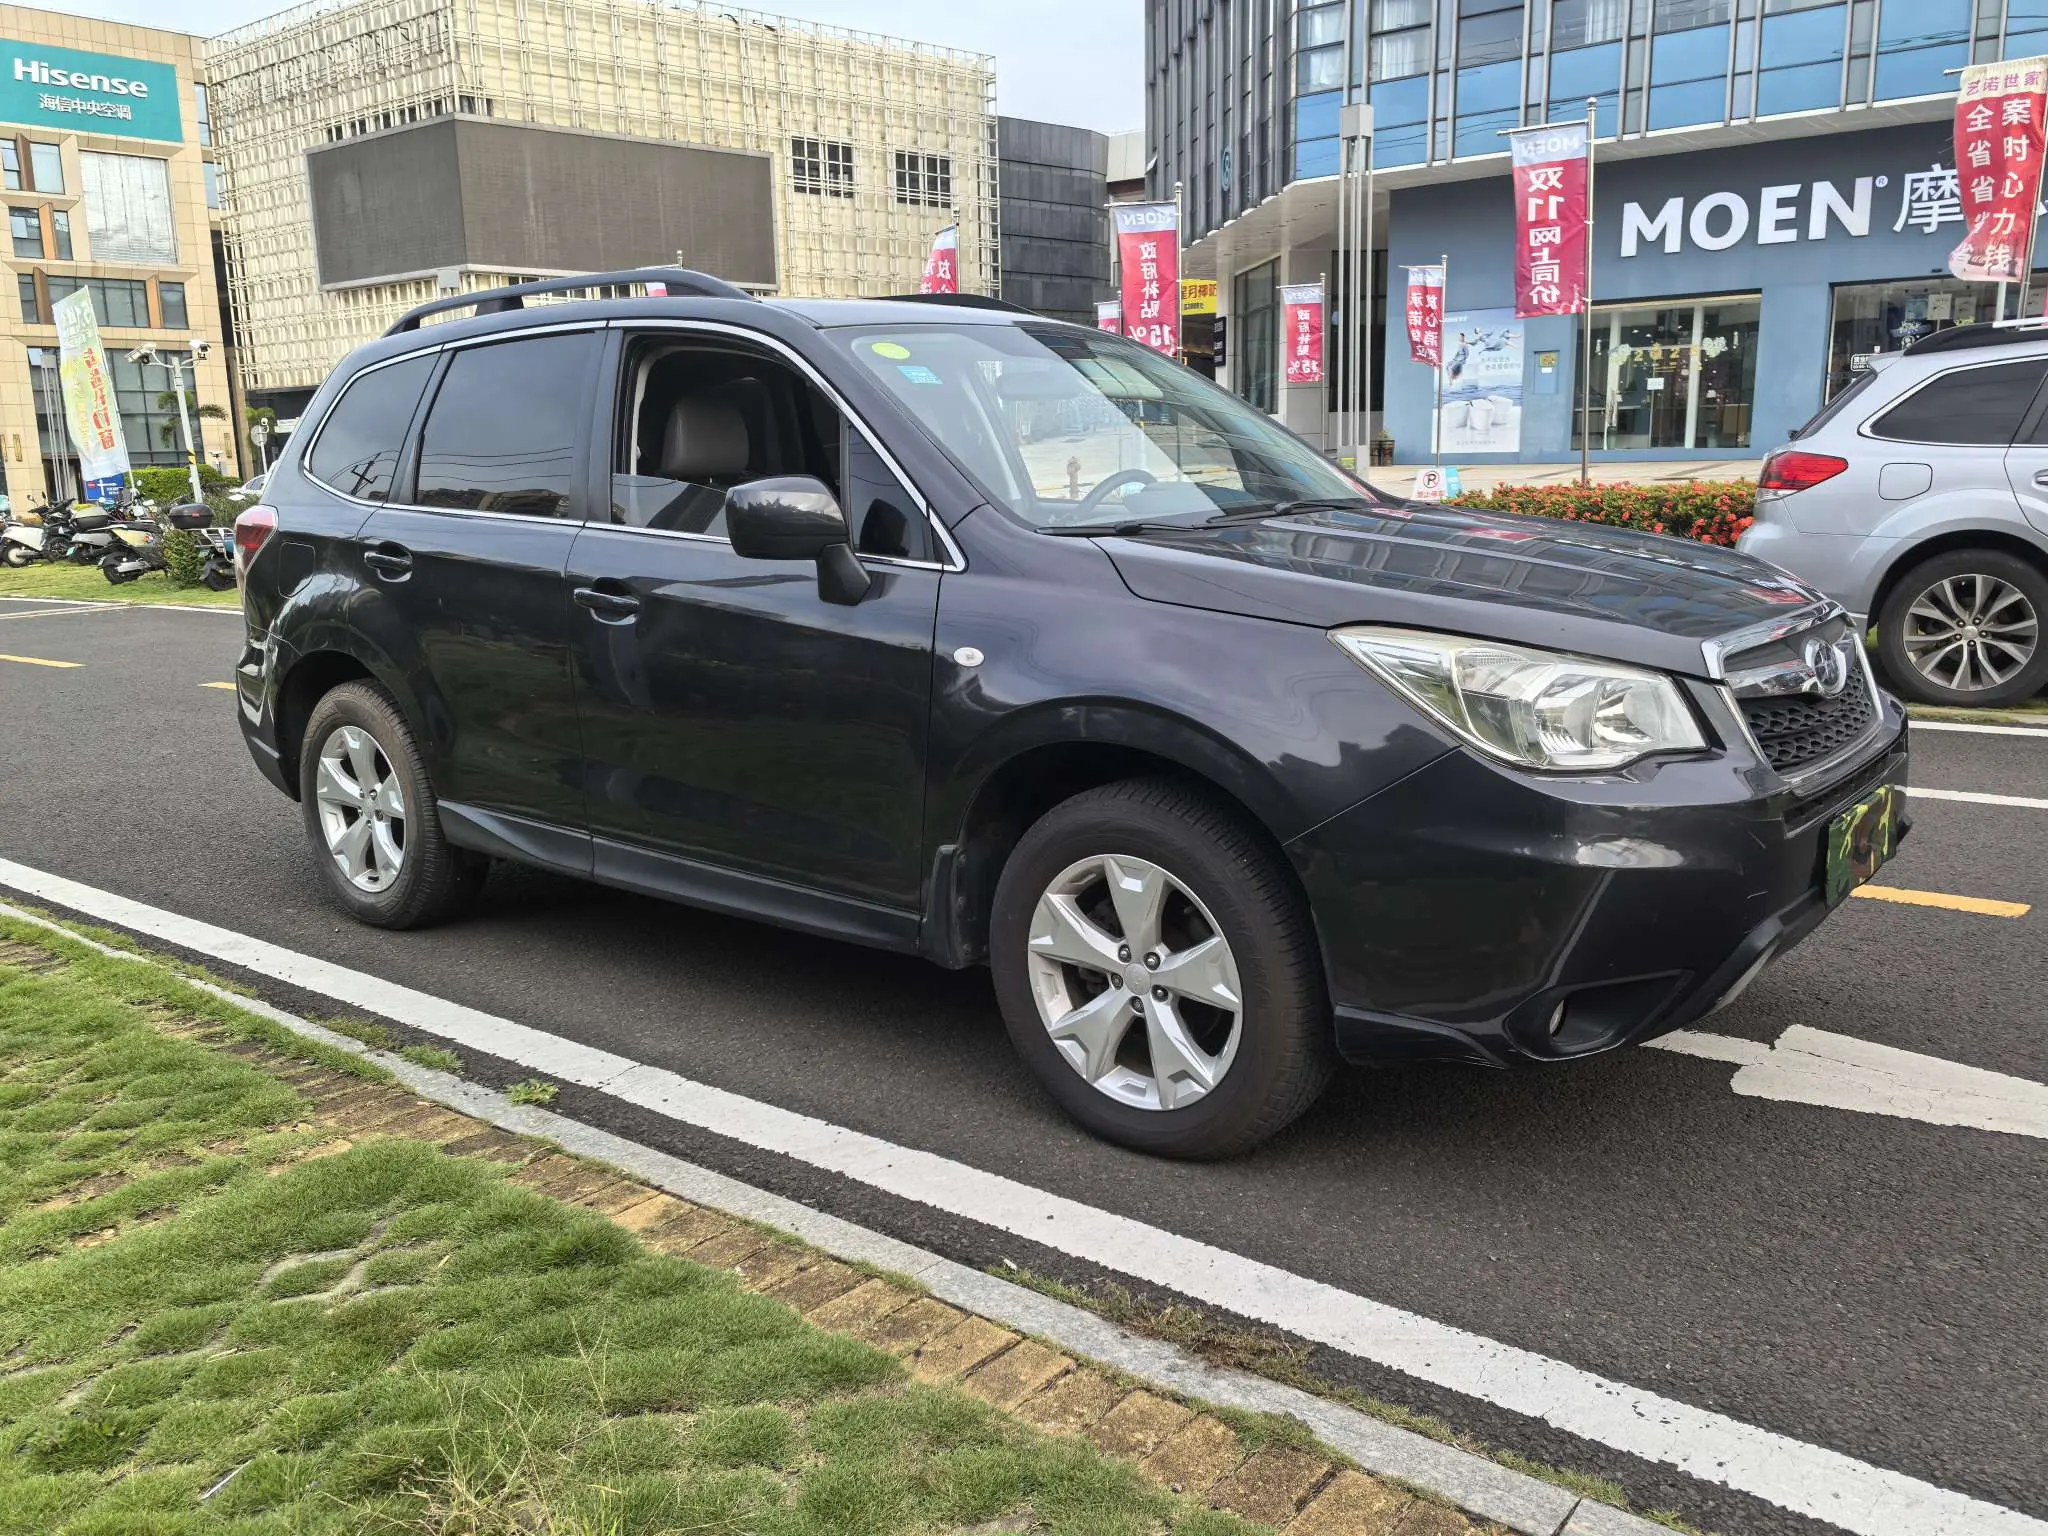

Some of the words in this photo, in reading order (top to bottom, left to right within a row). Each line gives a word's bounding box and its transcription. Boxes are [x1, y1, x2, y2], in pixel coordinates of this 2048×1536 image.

[14, 57, 149, 98] Hisense
[1966, 71, 2041, 96] 艺诺世家
[39, 93, 132, 121] 海信中央空调
